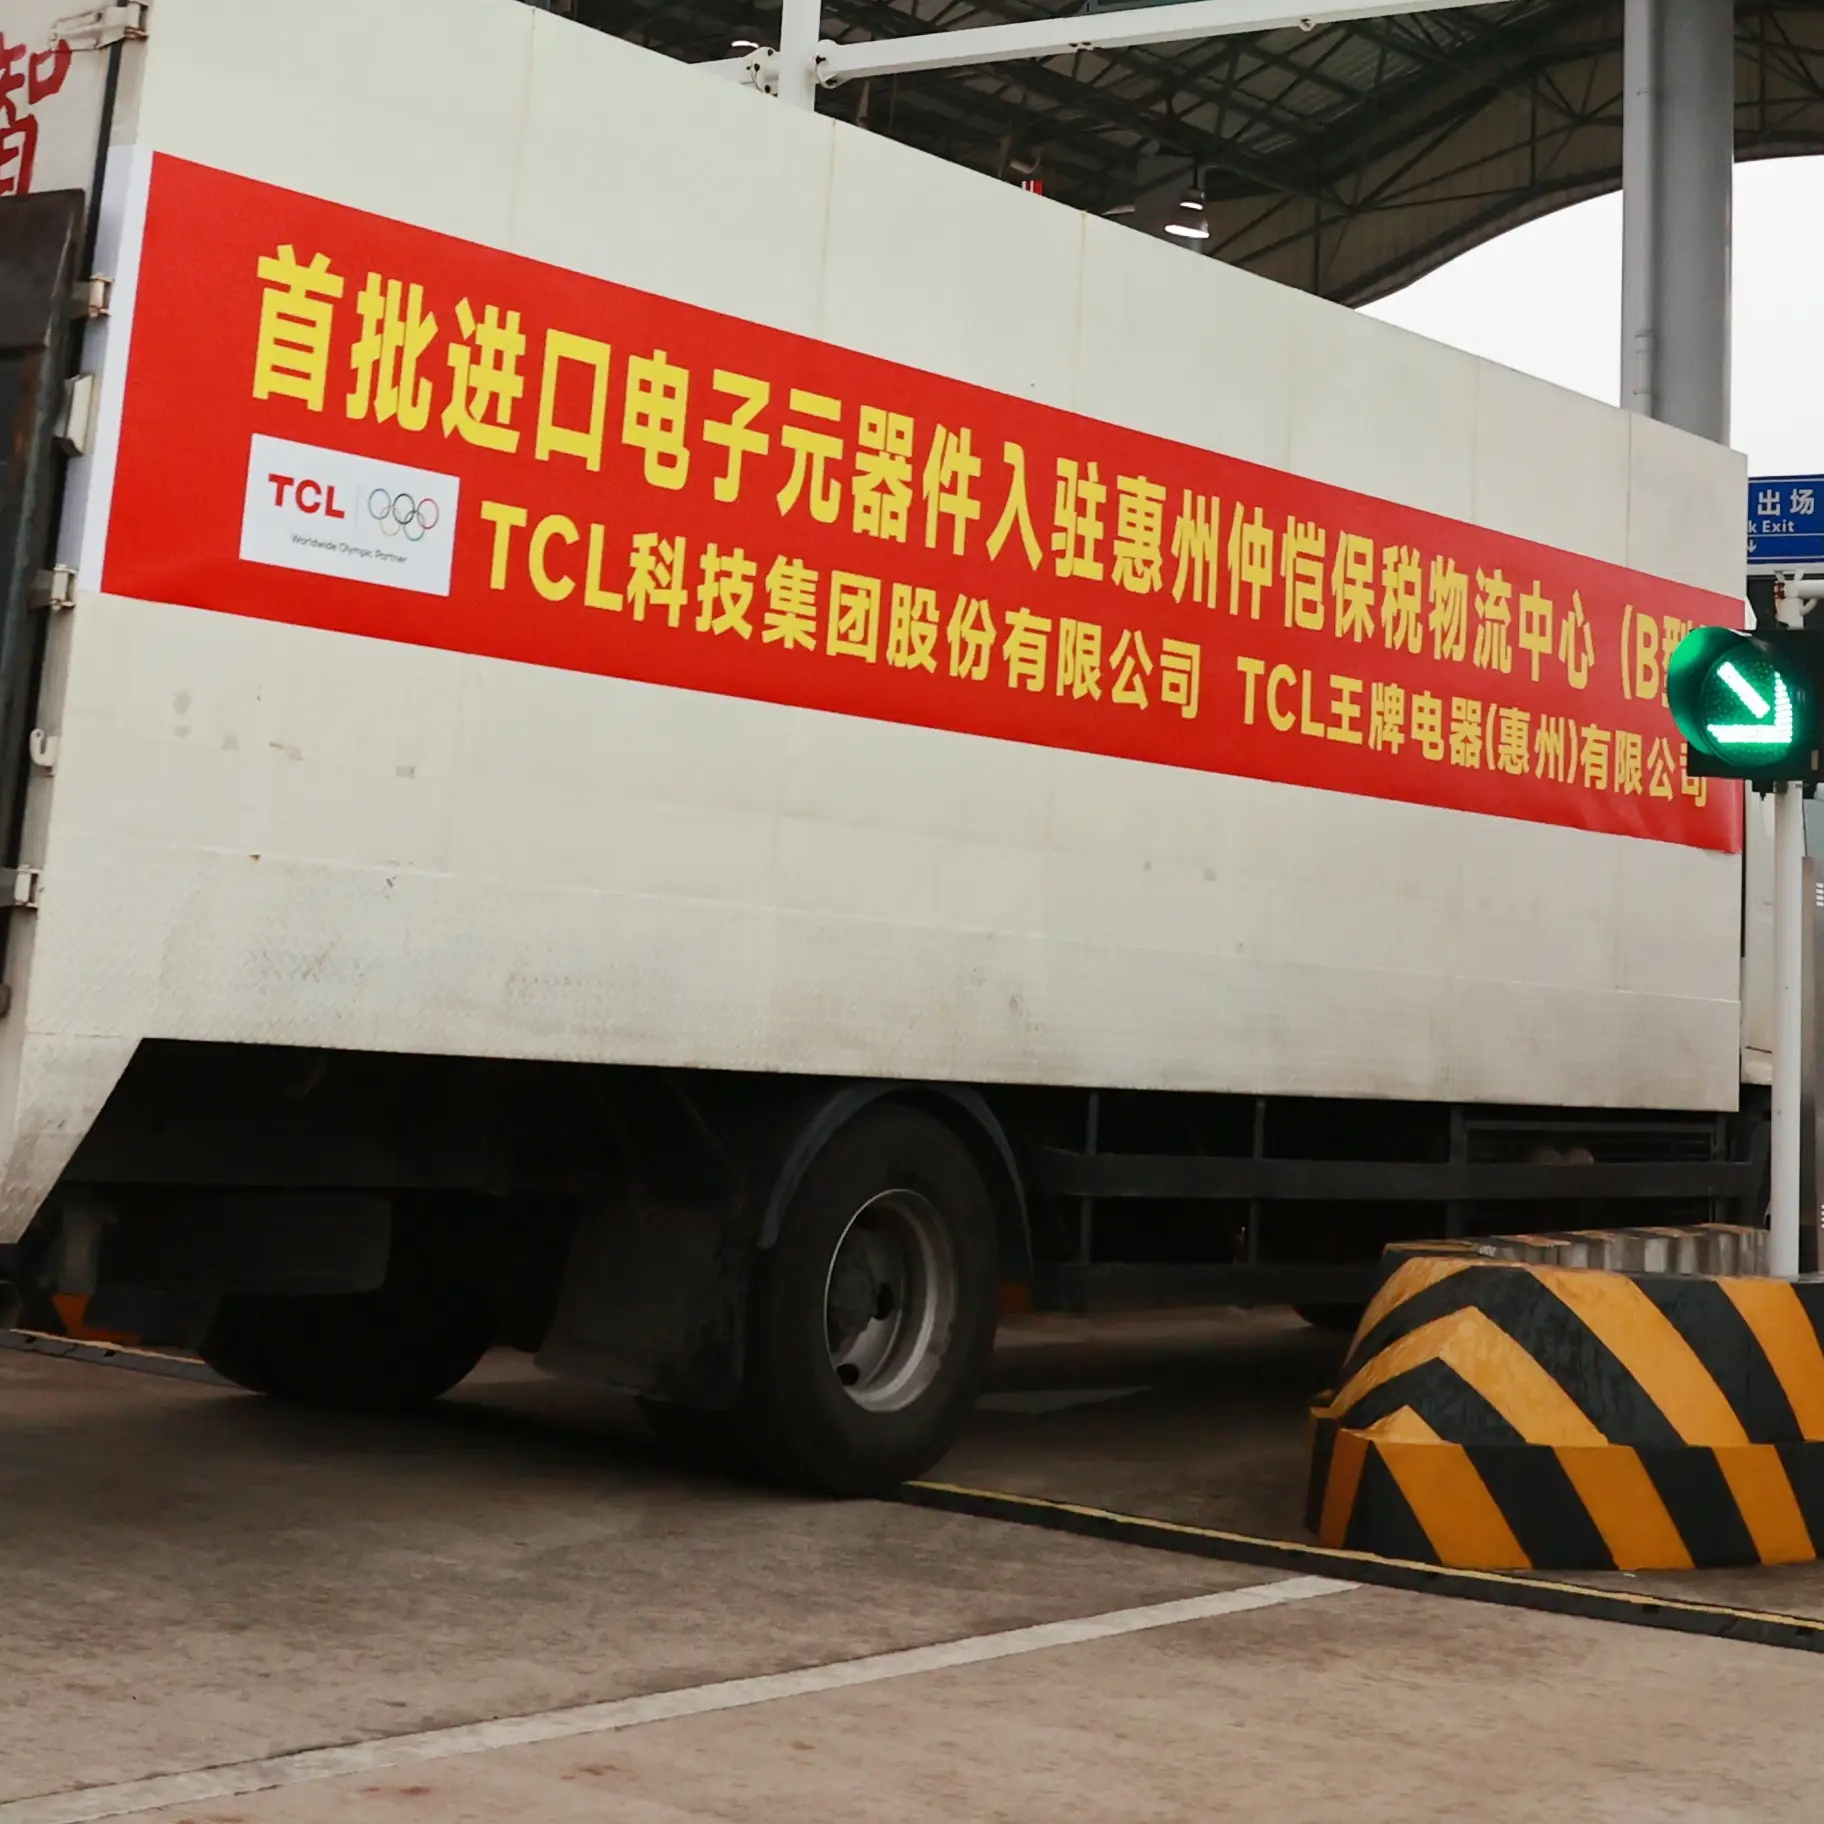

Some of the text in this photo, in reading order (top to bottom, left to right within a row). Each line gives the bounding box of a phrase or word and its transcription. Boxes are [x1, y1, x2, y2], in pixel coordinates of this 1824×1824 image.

[268, 473, 345, 519] TCL
[1757, 488, 1815, 516] 出场
[1762, 519, 1795, 534] Exit
[480, 501, 1201, 719] TCL科技集团股份有限公司
